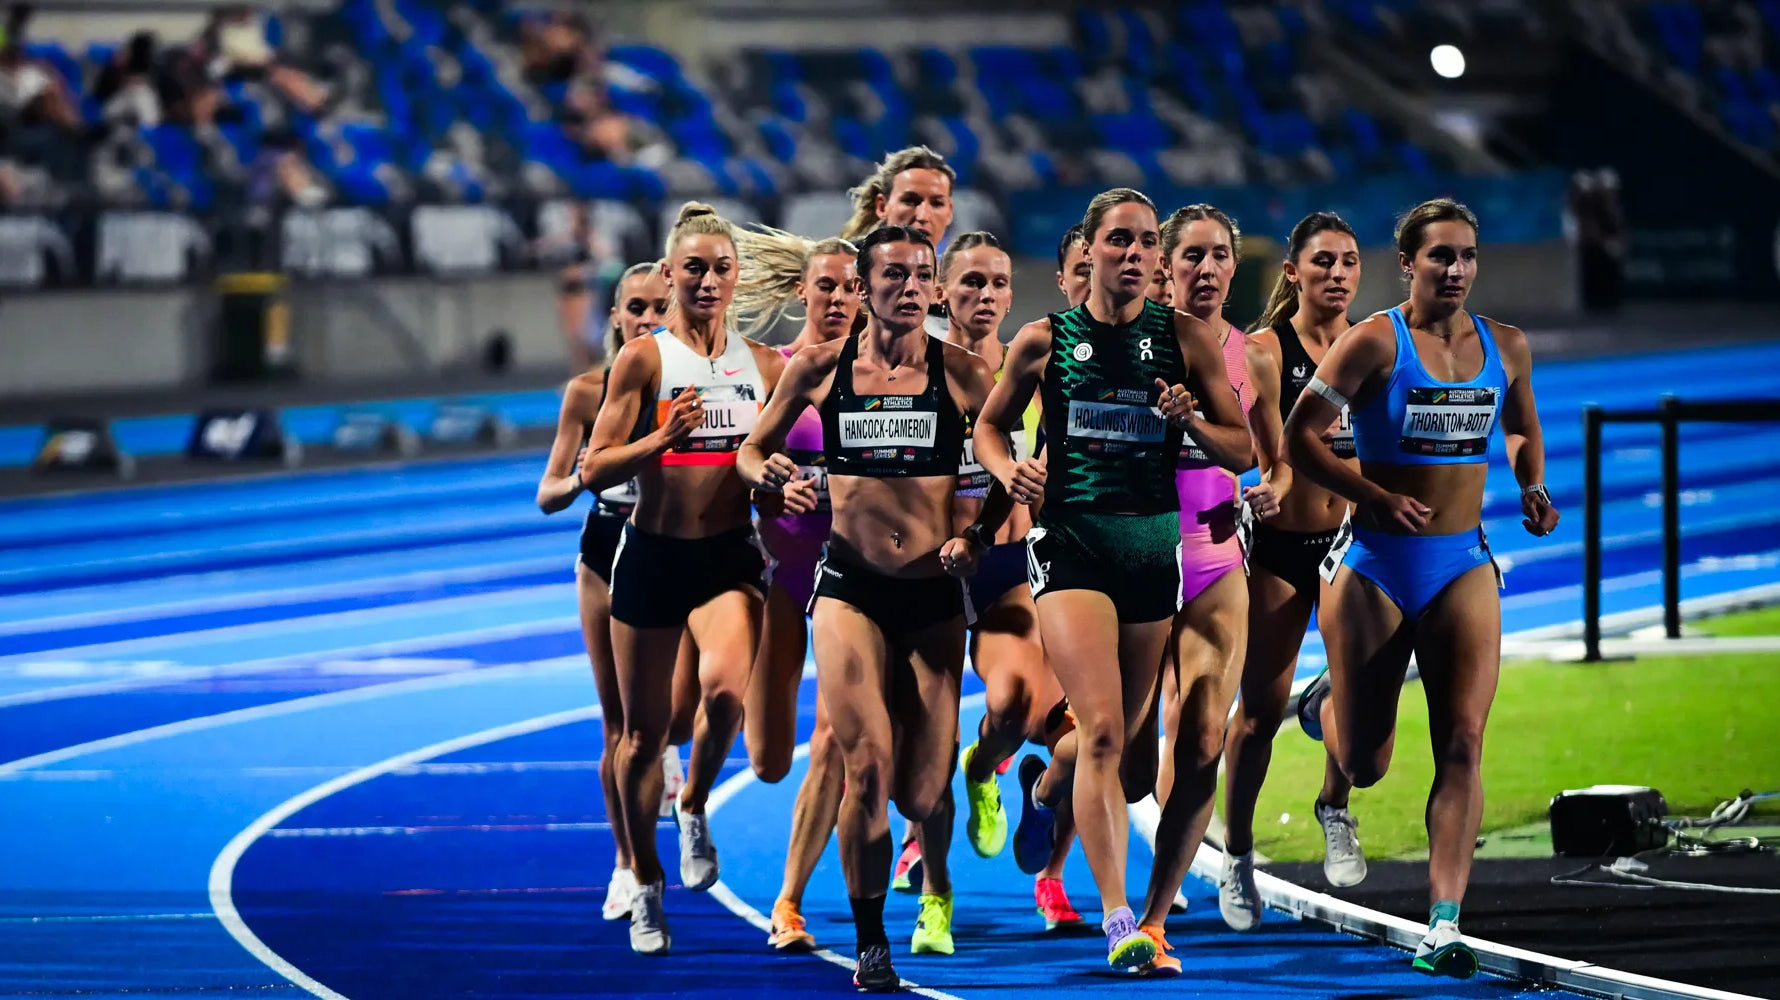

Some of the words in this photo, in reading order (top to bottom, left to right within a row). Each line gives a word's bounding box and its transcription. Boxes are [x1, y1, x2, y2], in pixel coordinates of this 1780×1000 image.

[699, 408, 736, 430] HULL
[844, 418, 931, 440] HANCOCK-CAMERON
[1075, 407, 1163, 435] HOLLINGSWORTH
[1410, 412, 1491, 433] THORNTON-BOTT
